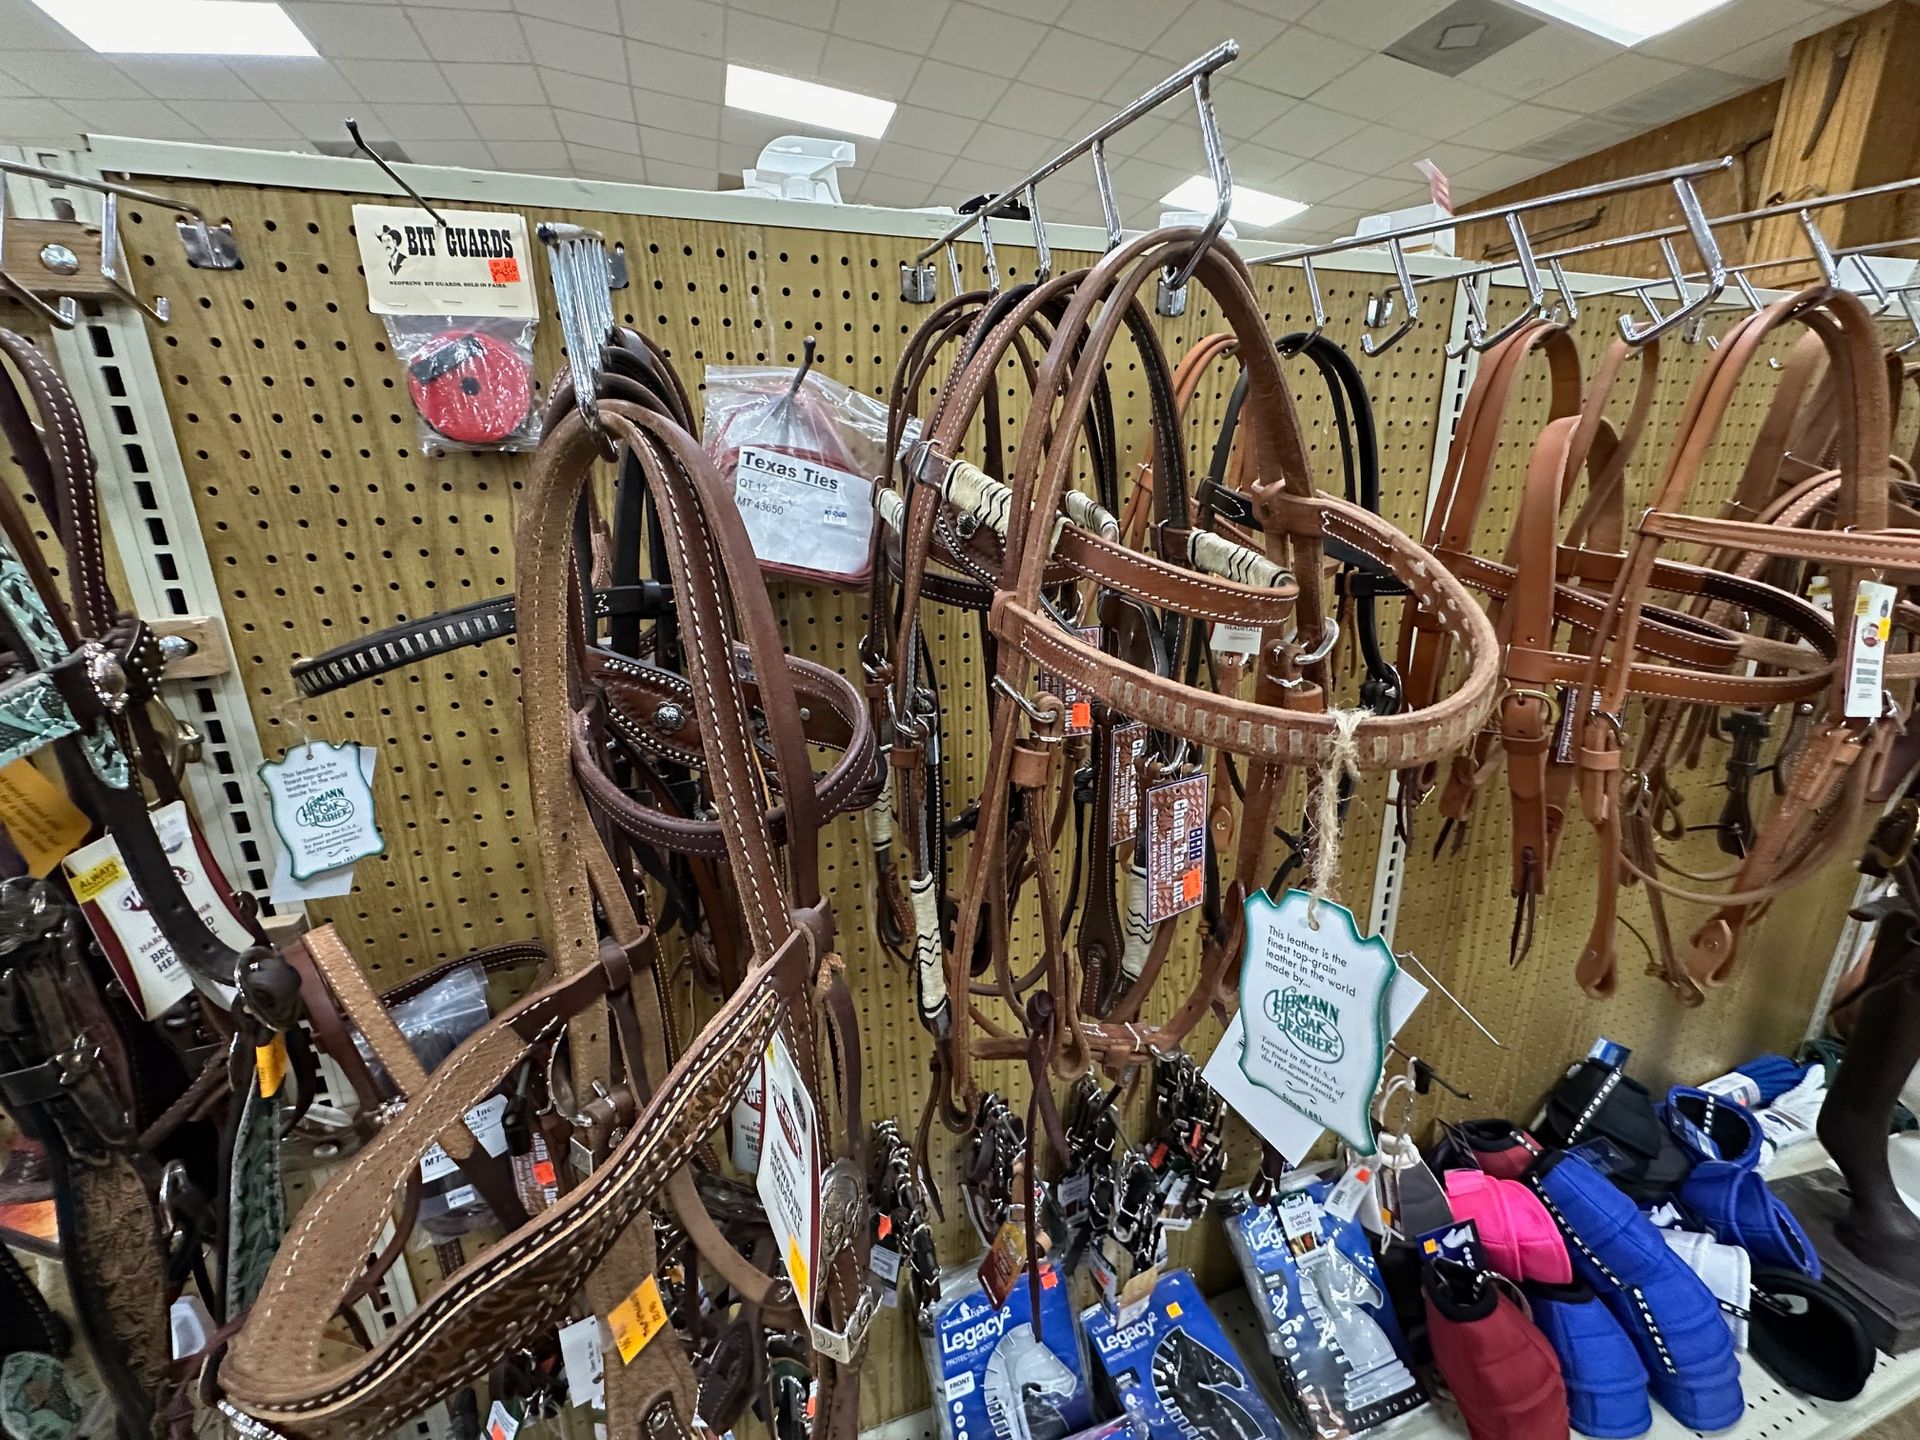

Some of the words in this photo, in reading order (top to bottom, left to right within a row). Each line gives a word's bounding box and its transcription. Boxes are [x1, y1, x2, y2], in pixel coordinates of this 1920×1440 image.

[404, 226, 436, 256] BIT
[445, 227, 514, 258] GUARDS
[739, 477, 754, 489] QT
[757, 483, 768, 493] 12
[742, 451, 797, 479] Texas
[803, 467, 839, 490] Ties
[296, 766, 319, 776] leather
[330, 771, 348, 781] world
[296, 787, 345, 826] HERMANN
[311, 806, 352, 826] LEATHER
[319, 800, 349, 814] OAK
[1172, 797, 1187, 841] Chem
[1171, 842, 1186, 876] Tac,
[1267, 936, 1291, 954] finest
[1293, 949, 1337, 975] top-grain
[1269, 925, 1284, 940] This
[1286, 932, 1320, 955] leather
[1322, 948, 1330, 960] is
[1332, 953, 1347, 967] the
[1265, 961, 1290, 978] made
[1292, 971, 1311, 989] by...
[1266, 947, 1297, 969] leather
[1299, 963, 1308, 974] in
[1310, 969, 1325, 982] the
[1328, 978, 1356, 997] world
[1263, 986, 1340, 1027] HERMANN
[1278, 1009, 1338, 1058] LEATHER
[1295, 1007, 1334, 1041] OAK
[1260, 1036, 1289, 1055] Tanned
[1290, 1052, 1298, 1061] in
[1300, 1058, 1312, 1069] the
[1261, 1054, 1272, 1064] the
[1273, 1060, 1309, 1086] Hermann
[1261, 1044, 1270, 1054] by
[1271, 1051, 1287, 1063] four
[1288, 1062, 1333, 1091] generations
[1335, 1089, 1345, 1098] of
[1281, 1093, 1301, 1110] Since
[1289, 1210, 1311, 1222] QUALITY
[941, 1315, 961, 1330] Classic
[945, 1349, 979, 1367] PROTECTIVE
[980, 1340, 994, 1353] BOOT
[949, 1376, 970, 1390] FRONT
[1354, 1410, 1380, 1426] PLAY
[1386, 1402, 1399, 1415] TO
